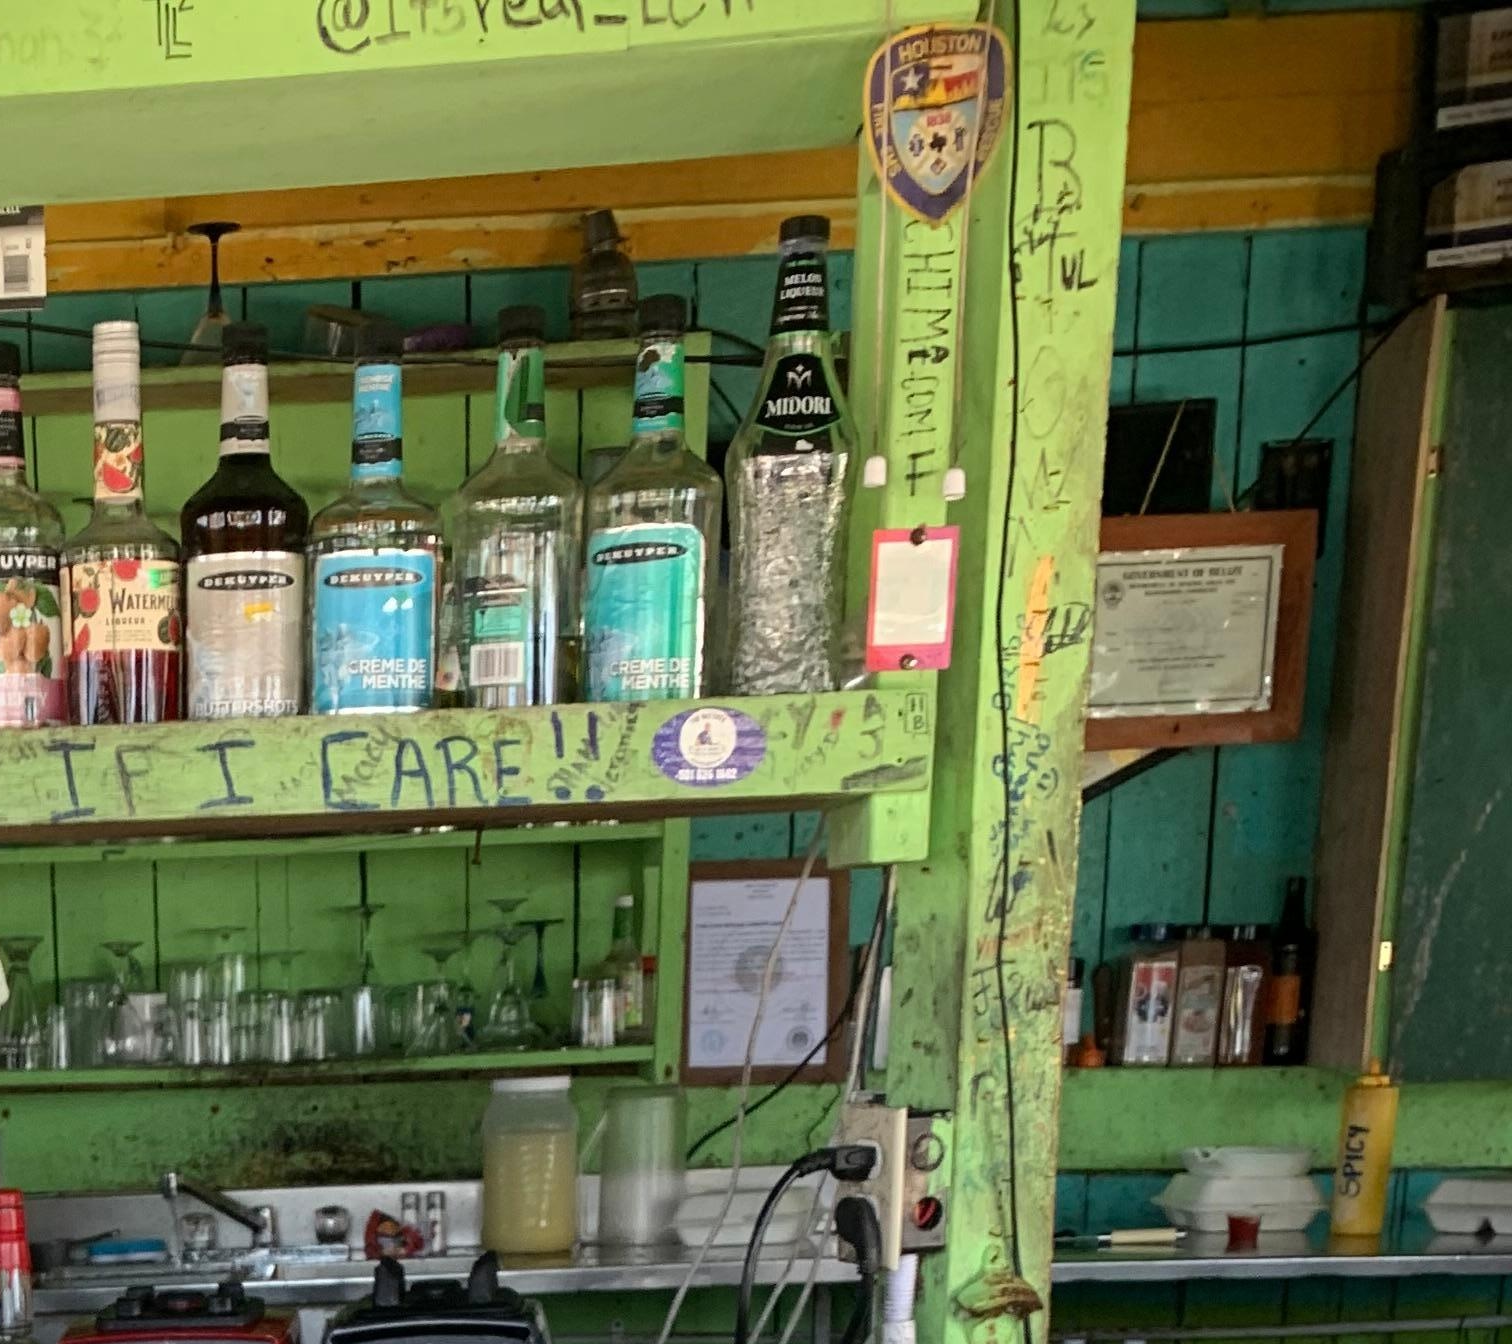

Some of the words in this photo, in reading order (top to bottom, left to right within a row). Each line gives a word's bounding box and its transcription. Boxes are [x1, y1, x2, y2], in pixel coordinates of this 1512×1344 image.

[898, 35, 983, 62] HOUSTON
[764, 396, 833, 419] MIDORI
[409, 657, 427, 673] DE
[668, 657, 690, 672] DE
[361, 673, 427, 690] MENTHE
[622, 674, 690, 691] MENTHE
[45, 739, 151, 823] IF
[195, 739, 256, 809] I
[1339, 1124, 1371, 1198] SPICY
